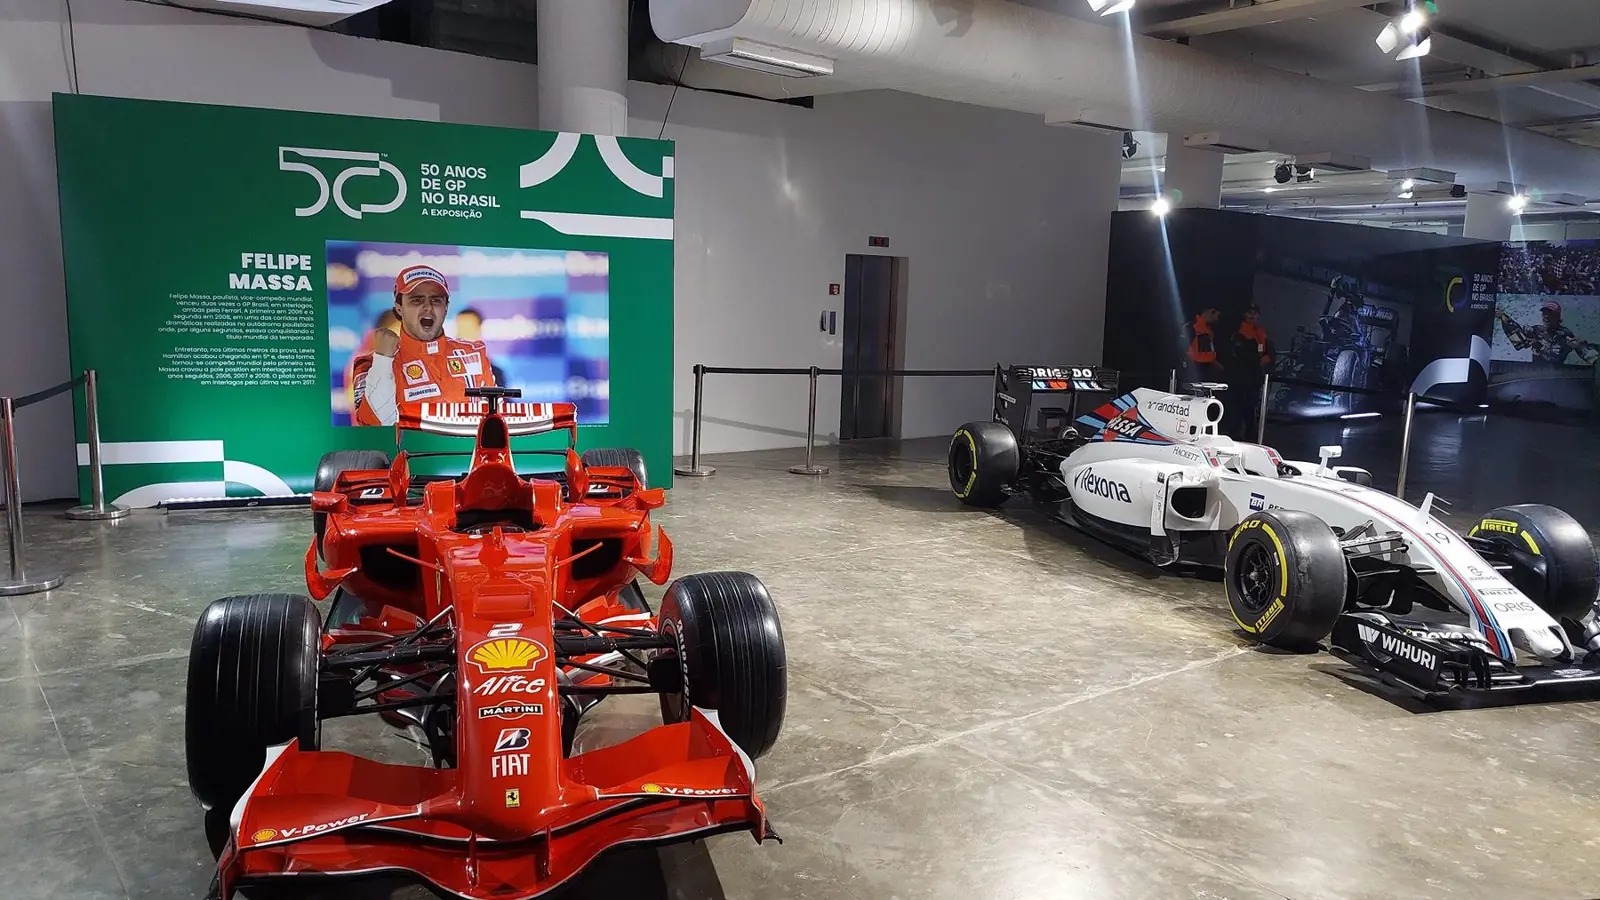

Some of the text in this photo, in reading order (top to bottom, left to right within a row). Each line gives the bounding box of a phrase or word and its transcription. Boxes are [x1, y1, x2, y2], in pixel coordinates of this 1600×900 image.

[420, 164, 487, 179] 50 ANOS
[420, 178, 466, 192] DE GP
[421, 192, 500, 208] NO BRASIL
[421, 208, 482, 219] A EXPOSIÇÃO
[241, 252, 312, 271] FELIPE
[229, 273, 313, 291] MASSA
[1154, 401, 1190, 417] randstad
[1173, 446, 1200, 462] HACKETT
[1080, 466, 1132, 503] Rexona
[1481, 519, 1519, 534] PIRELLI
[1427, 532, 1450, 545] 19
[1255, 597, 1285, 633] PIRELLI
[1494, 602, 1535, 612] ORIS
[487, 623, 523, 637] 2
[1382, 632, 1436, 671] WIHURI
[473, 675, 546, 696] Alice
[483, 705, 539, 716] MARTINI
[491, 754, 531, 778] FIAT
[664, 787, 739, 795] V-Power
[280, 813, 369, 838] V-Power
